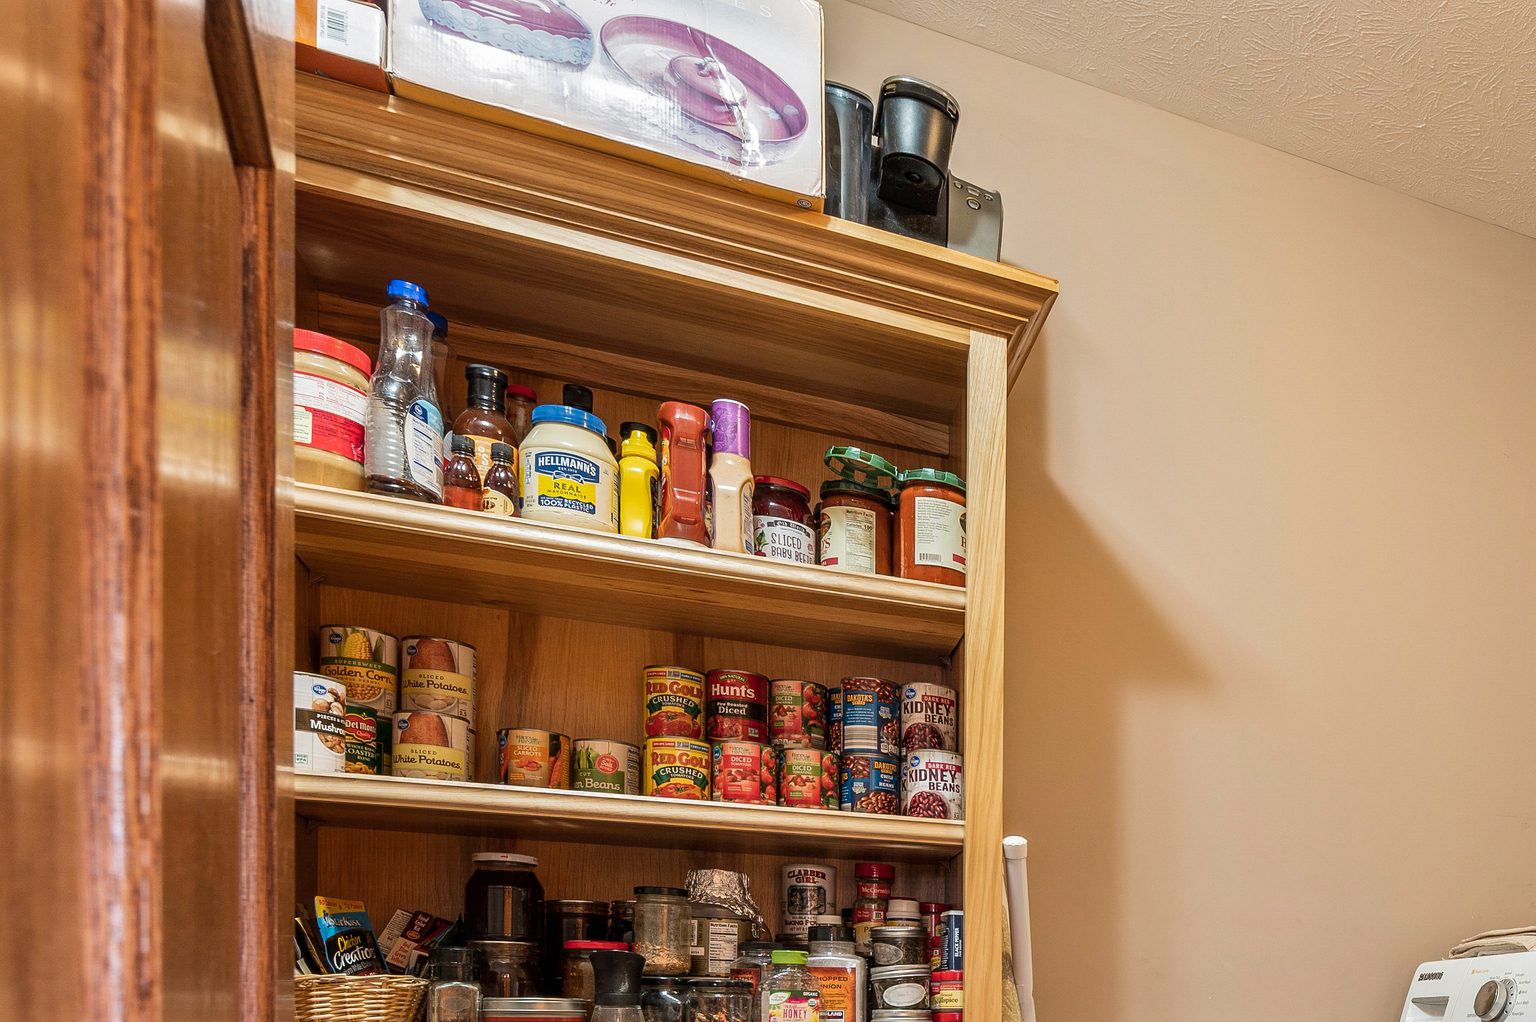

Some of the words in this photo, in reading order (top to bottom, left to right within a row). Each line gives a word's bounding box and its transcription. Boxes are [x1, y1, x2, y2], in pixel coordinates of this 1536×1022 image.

[538, 456, 596, 476] HELLMANN'S
[554, 483, 581, 493] REAL
[565, 498, 593, 509] RECYCLED
[771, 533, 802, 550] SLICED
[771, 546, 792, 559] BABY
[335, 659, 382, 669] SUPERSWEET
[325, 665, 363, 678] Golden
[403, 680, 425, 688] White
[646, 682, 667, 695] RED
[669, 682, 703, 698] GOLD
[653, 696, 694, 707] CRUSHED
[719, 706, 746, 715] Diced
[904, 701, 951, 716] KIDNEY
[346, 720, 358, 729] Del
[925, 715, 953, 726] BEANS
[393, 755, 417, 764] White
[601, 760, 613, 768] Salt
[651, 752, 676, 766] RED
[678, 753, 709, 768] GOLD
[660, 766, 703, 778] CRUSHED
[909, 769, 956, 783] KIDNEY
[929, 782, 960, 793] BEANS
[788, 870, 827, 880] CLABBER
[329, 915, 362, 927] StarKist
[338, 935, 361, 953] Chicken
[1418, 971, 1444, 982] SAMSUNG
[783, 1009, 807, 1019] HONEY
